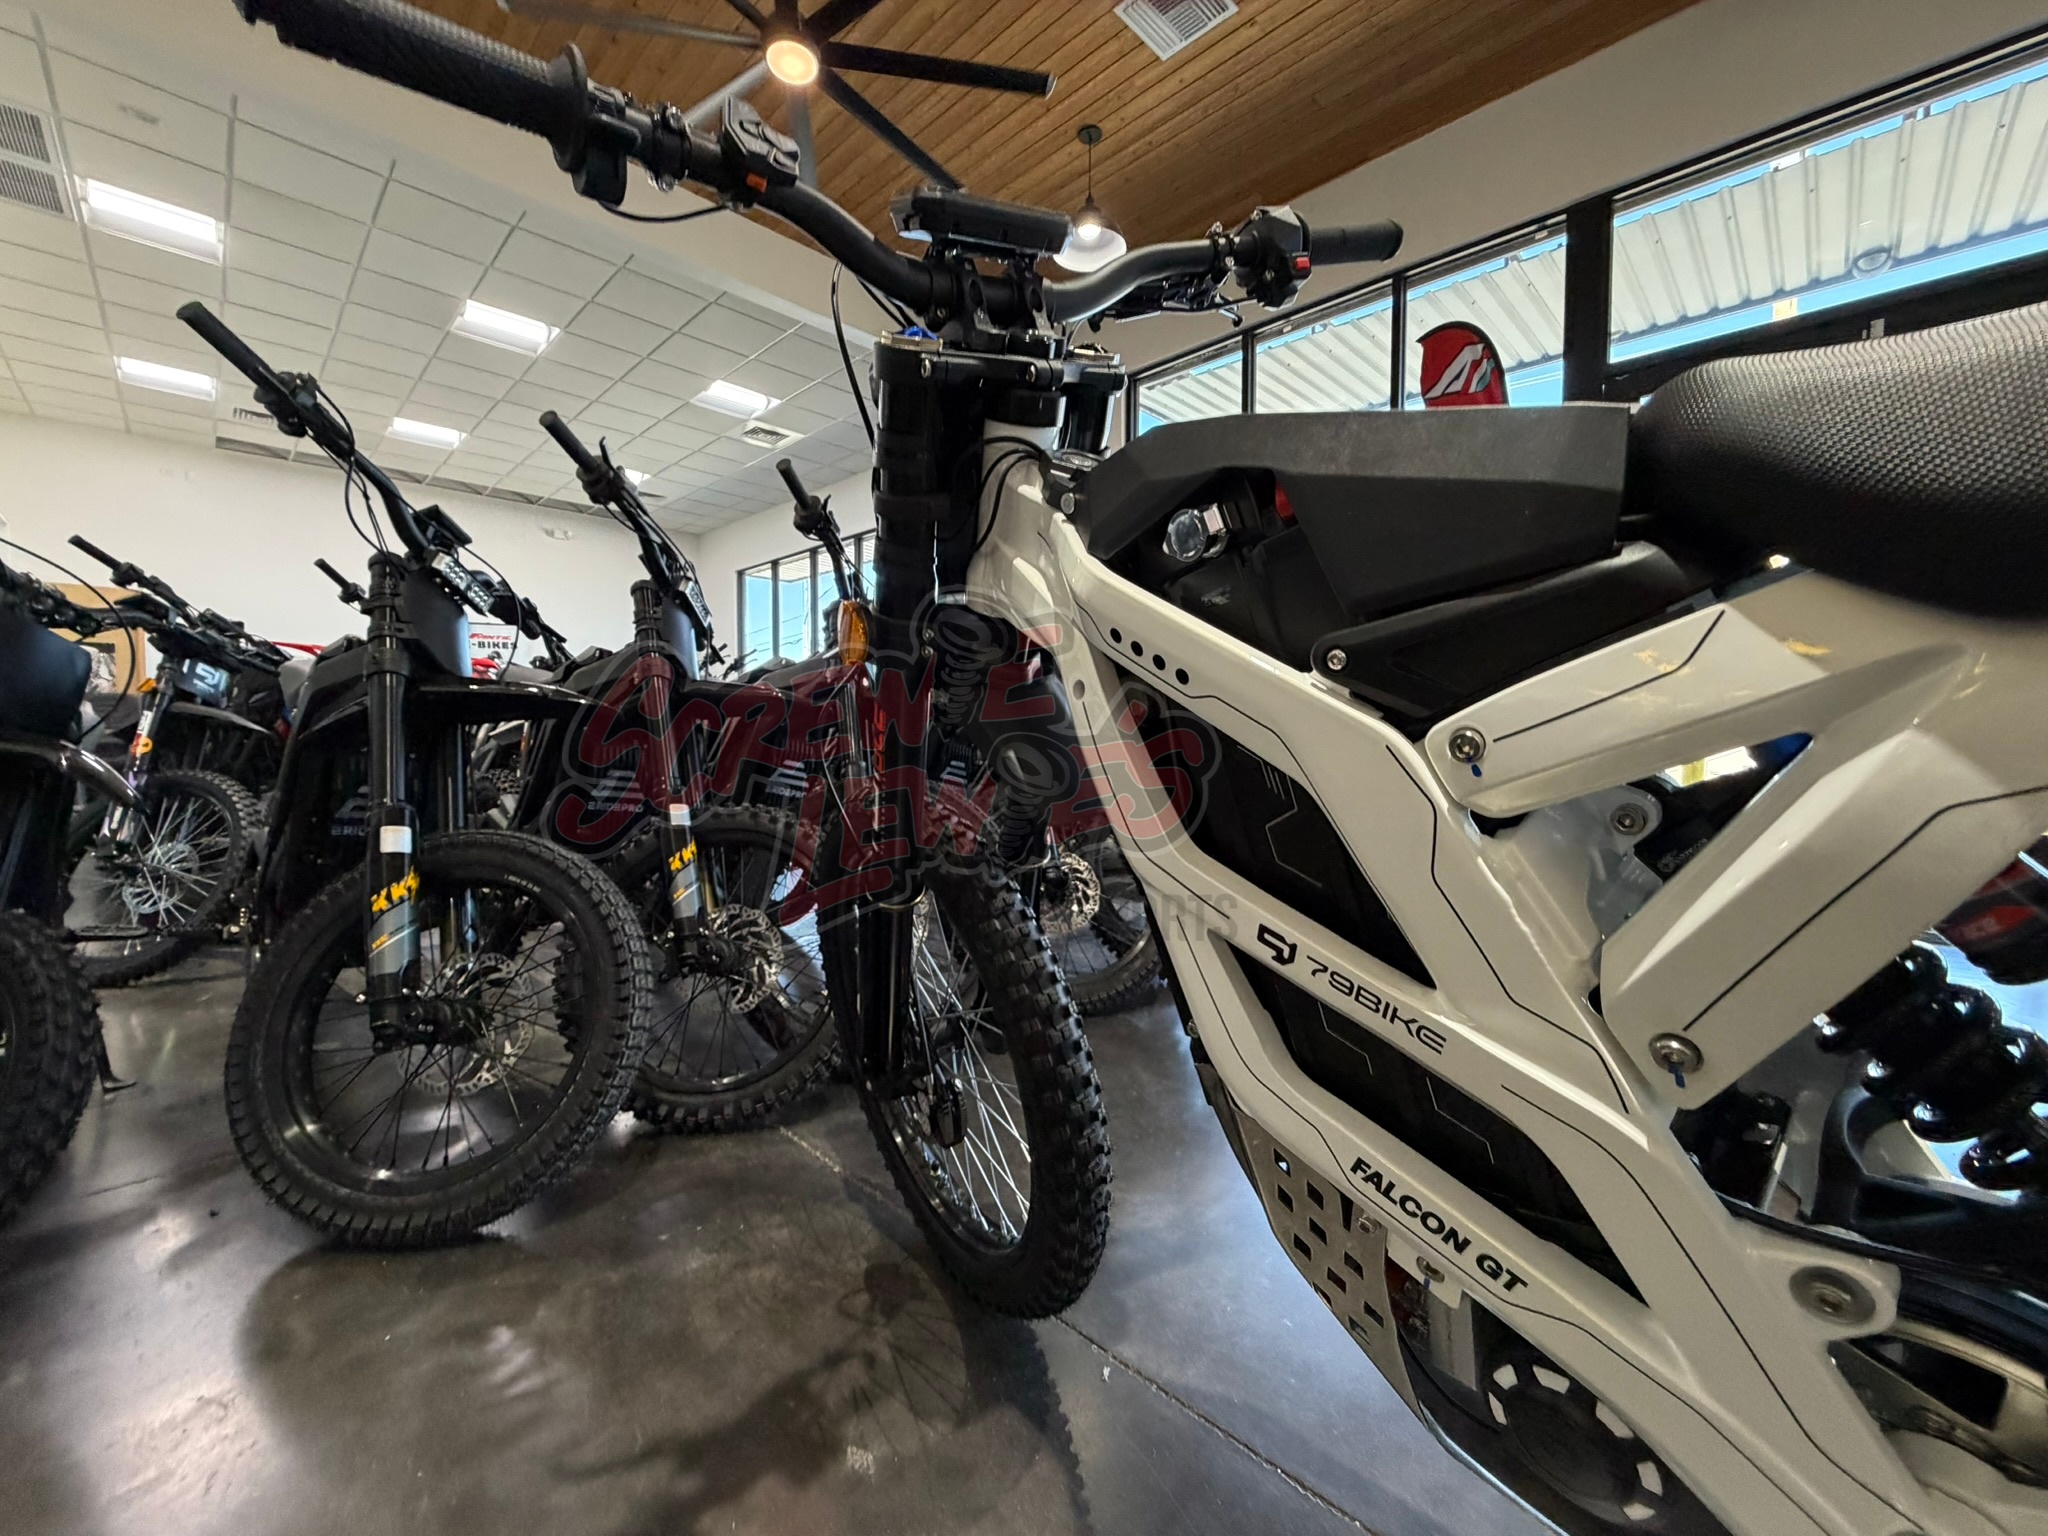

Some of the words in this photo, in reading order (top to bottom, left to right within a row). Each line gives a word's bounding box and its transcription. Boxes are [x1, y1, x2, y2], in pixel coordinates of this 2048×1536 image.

[1306, 956, 1447, 1055] 79BIKE
[1350, 1157, 1471, 1255] FALCON
[1475, 1253, 1529, 1293] GT
